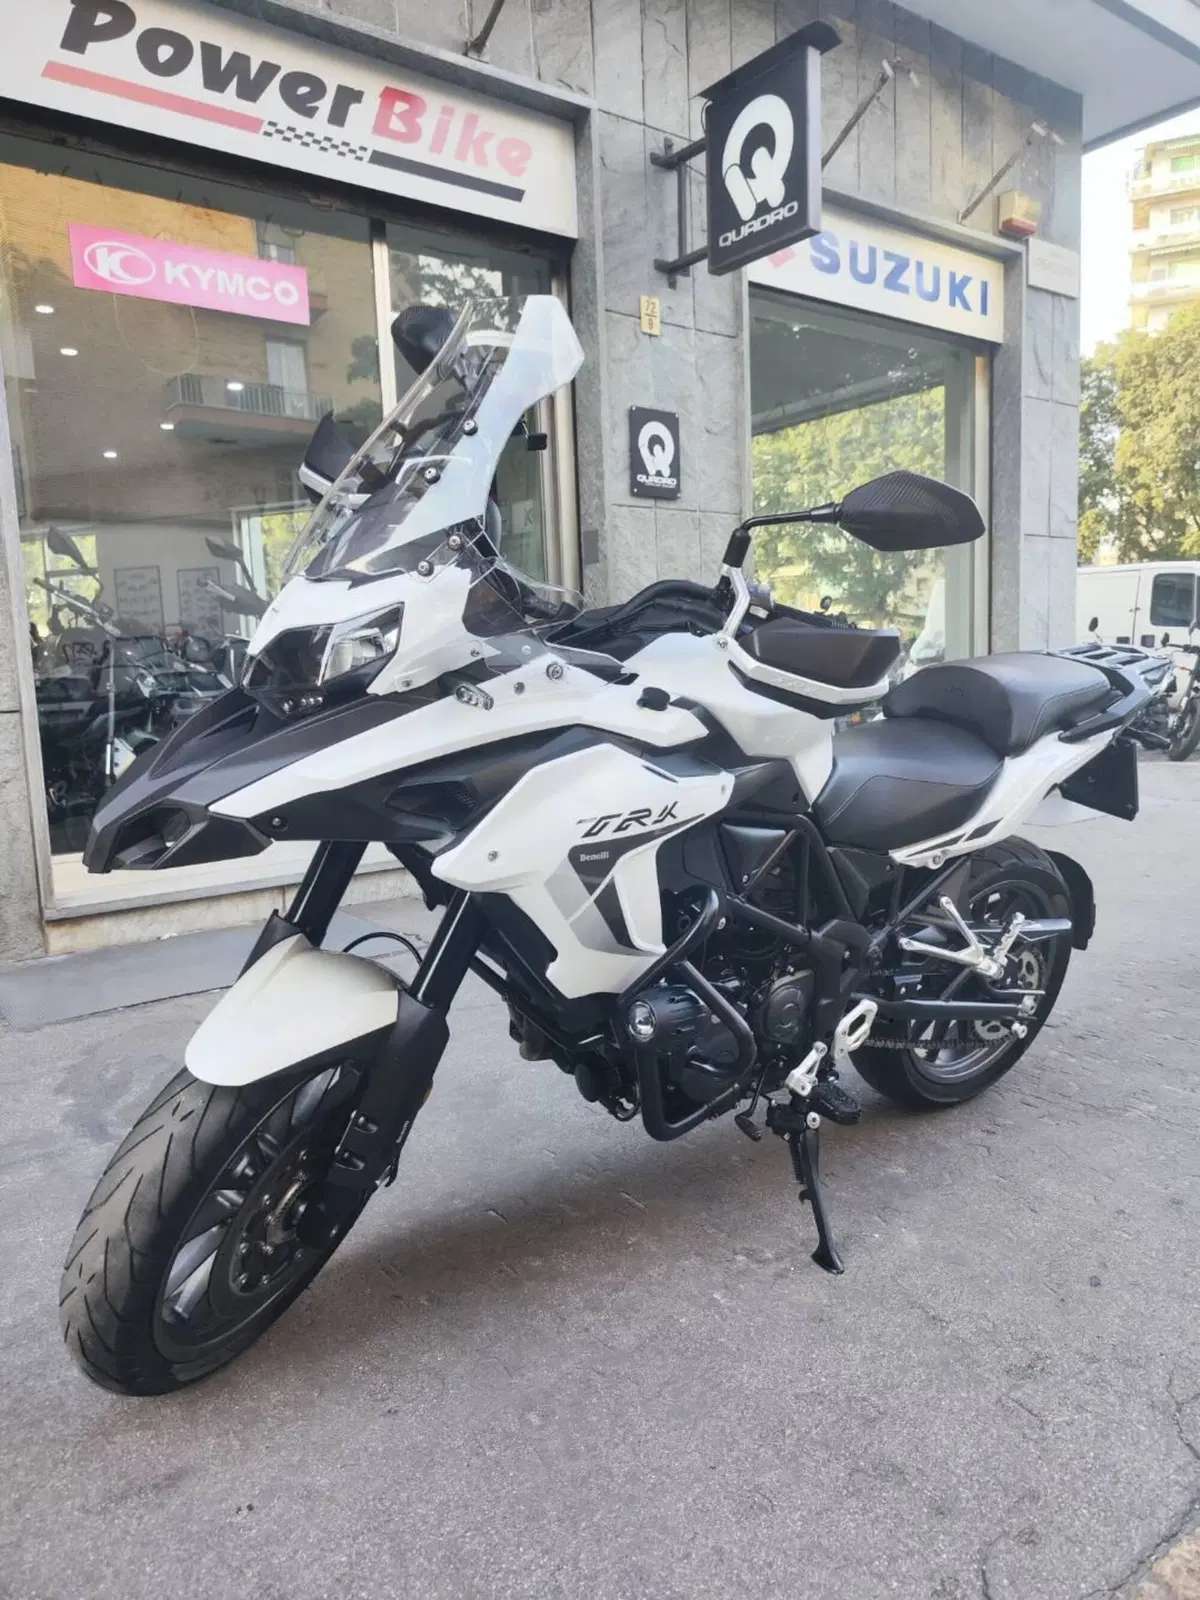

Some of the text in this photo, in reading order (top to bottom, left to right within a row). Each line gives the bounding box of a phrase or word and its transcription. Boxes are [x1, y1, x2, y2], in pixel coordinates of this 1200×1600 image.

[718, 200, 799, 248] QUADRO
[163, 259, 299, 305] KYMCO
[809, 231, 989, 316] SUZUKI
[576, 800, 678, 838] TRK
[580, 851, 609, 862] Benelli
